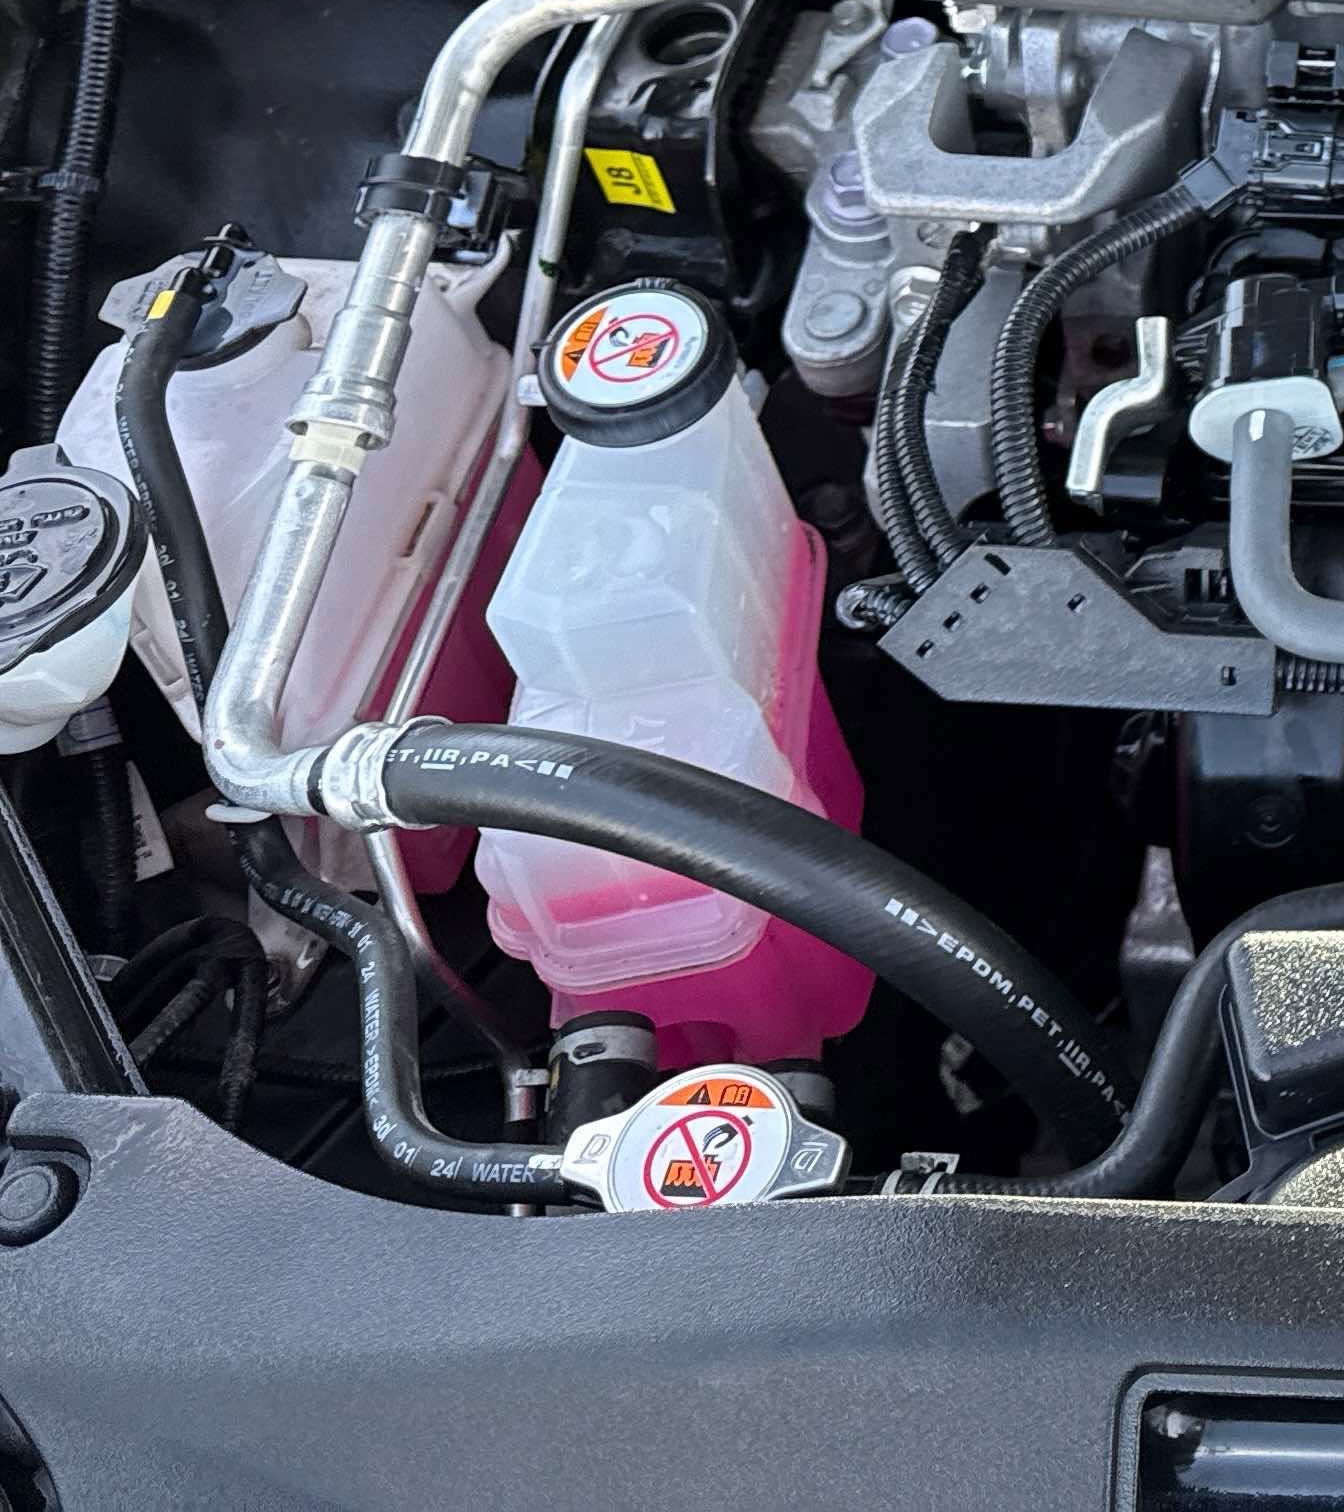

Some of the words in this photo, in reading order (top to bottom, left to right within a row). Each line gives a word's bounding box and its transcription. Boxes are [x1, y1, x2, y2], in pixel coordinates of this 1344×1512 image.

[606, 167, 642, 196] J8
[364, 988, 381, 1046] WATER
[470, 1163, 537, 1184] WATER
